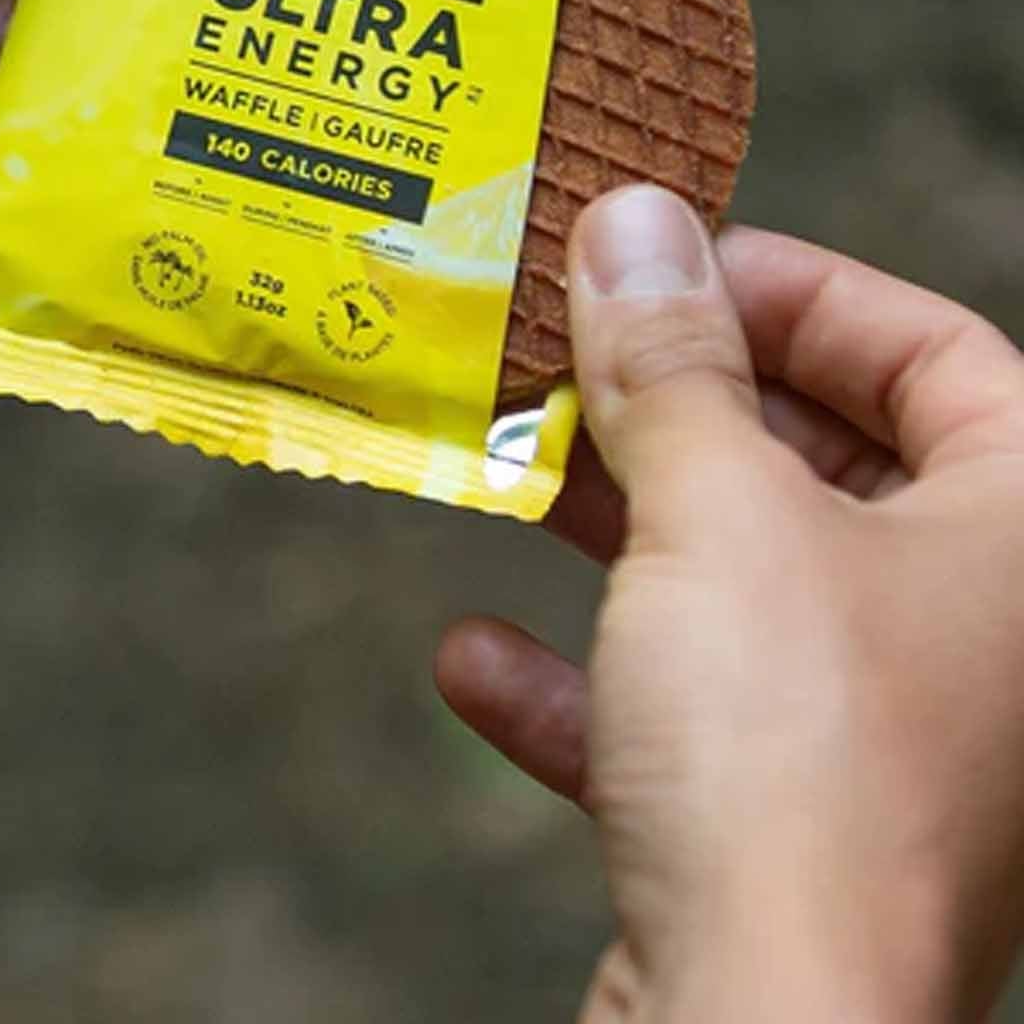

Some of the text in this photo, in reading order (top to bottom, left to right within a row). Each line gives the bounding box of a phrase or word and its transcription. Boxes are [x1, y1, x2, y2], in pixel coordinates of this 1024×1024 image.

[194, 15, 461, 113] ENERGY
[184, 76, 444, 165] WAFFLE GAUFRE
[205, 132, 253, 163] 140
[260, 148, 394, 202] CALORIES
[249, 270, 285, 295] 32g
